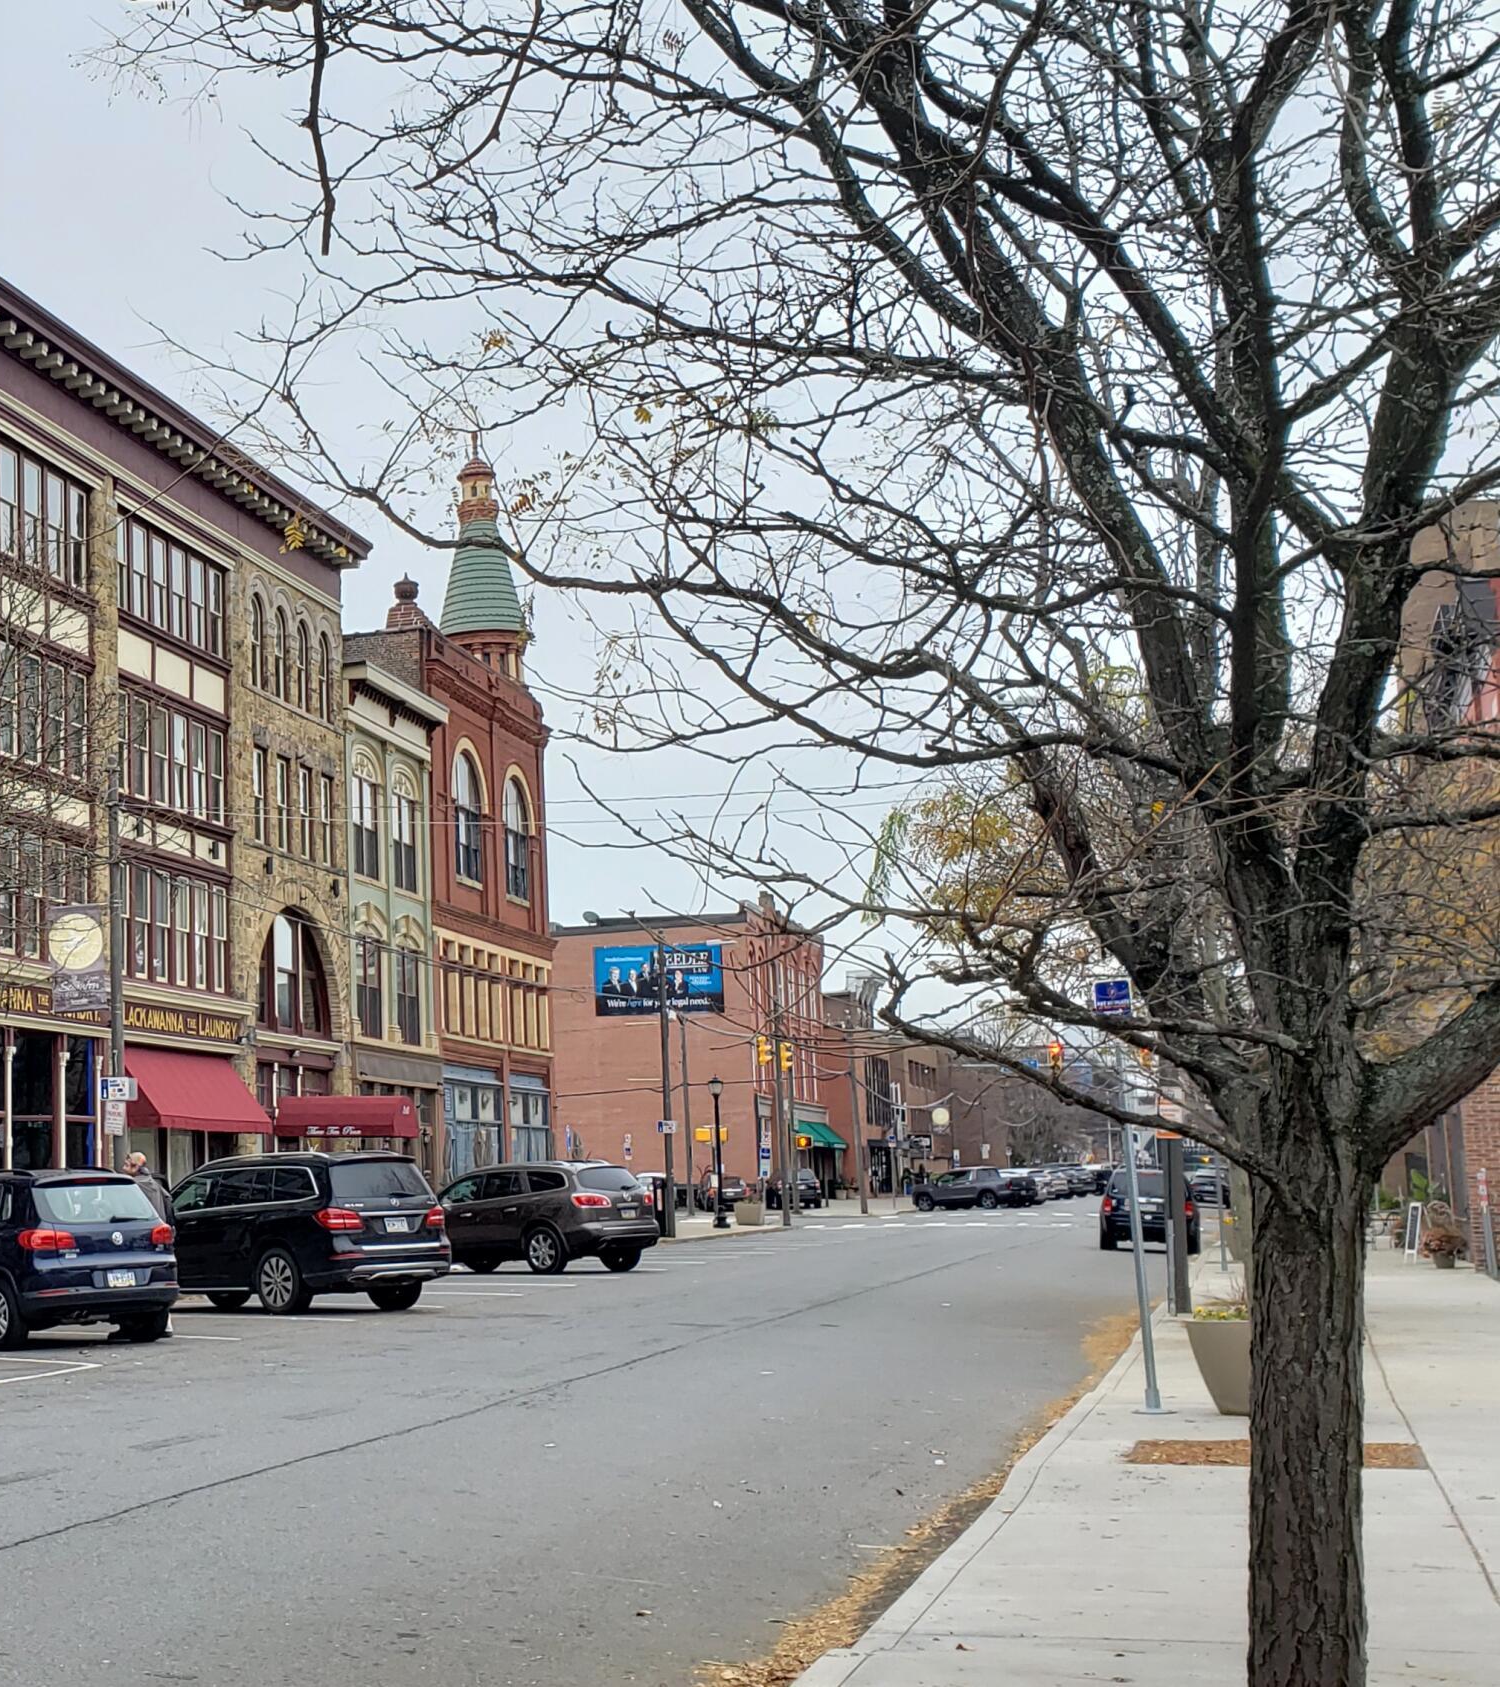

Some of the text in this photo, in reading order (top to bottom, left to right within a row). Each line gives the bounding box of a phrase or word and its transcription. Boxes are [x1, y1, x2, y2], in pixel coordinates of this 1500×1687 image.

[655, 951, 709, 966] EEDLE
[654, 999, 671, 1008] yor
[672, 997, 689, 1008] legal
[122, 1001, 184, 1034] LACKAWANNA
[187, 1018, 197, 1029] THE
